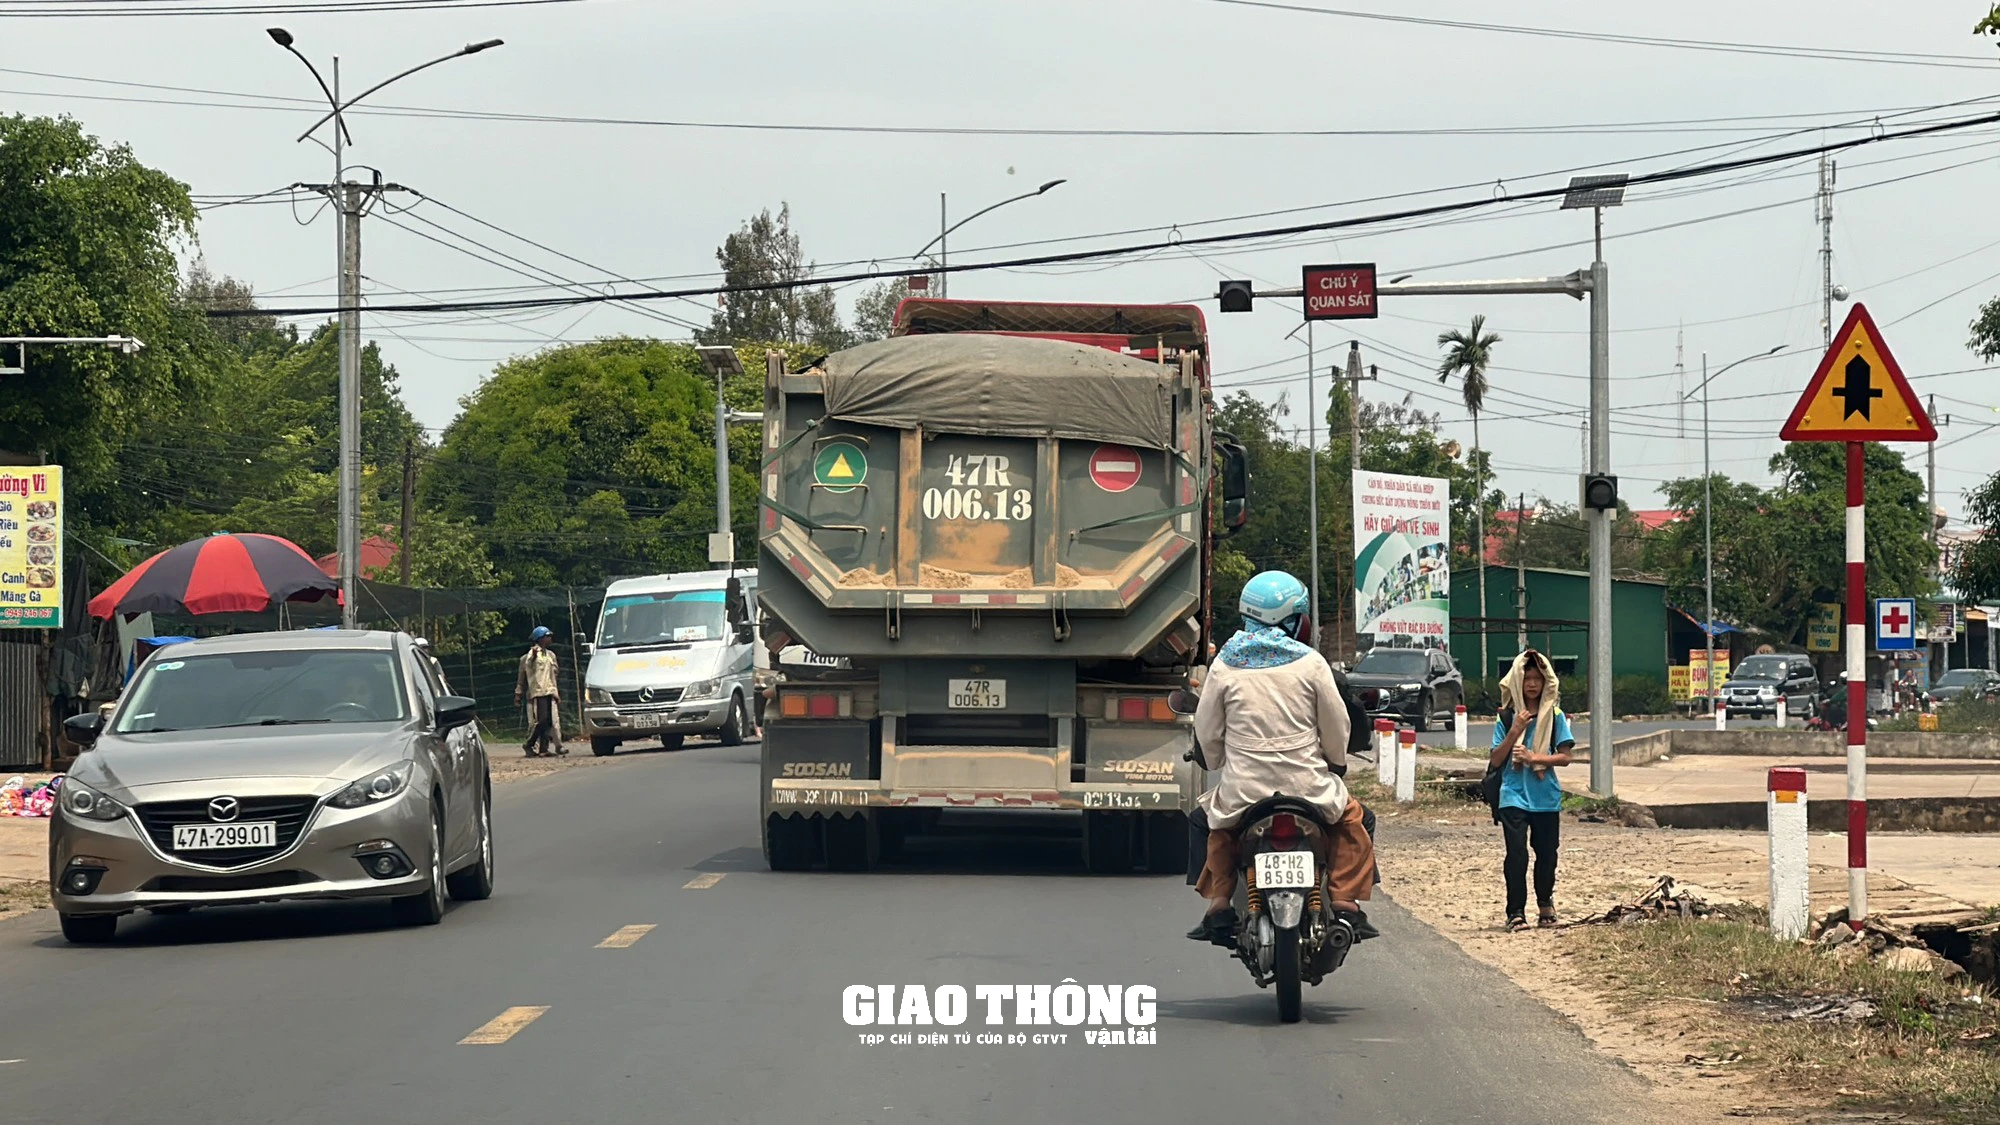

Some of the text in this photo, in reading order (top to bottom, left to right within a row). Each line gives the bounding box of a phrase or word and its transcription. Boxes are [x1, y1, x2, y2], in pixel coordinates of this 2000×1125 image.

[1320, 272, 1358, 289] CHÚ Ý
[1309, 290, 1371, 311] QUAN SÁT
[944, 454, 1012, 486] 47R
[32, 473, 45, 492] Vi
[922, 487, 1032, 521] 006.13
[1364, 513, 1379, 531] HÃY
[1422, 521, 1440, 536] SINH
[2, 572, 25, 584] Canh
[0, 590, 41, 604] Măng Gà
[965, 680, 990, 693] 47R
[954, 694, 1000, 707] 006.13
[782, 762, 851, 777] SOOSAN
[177, 825, 270, 848] 47A-299.01
[1264, 870, 1304, 885] 8599
